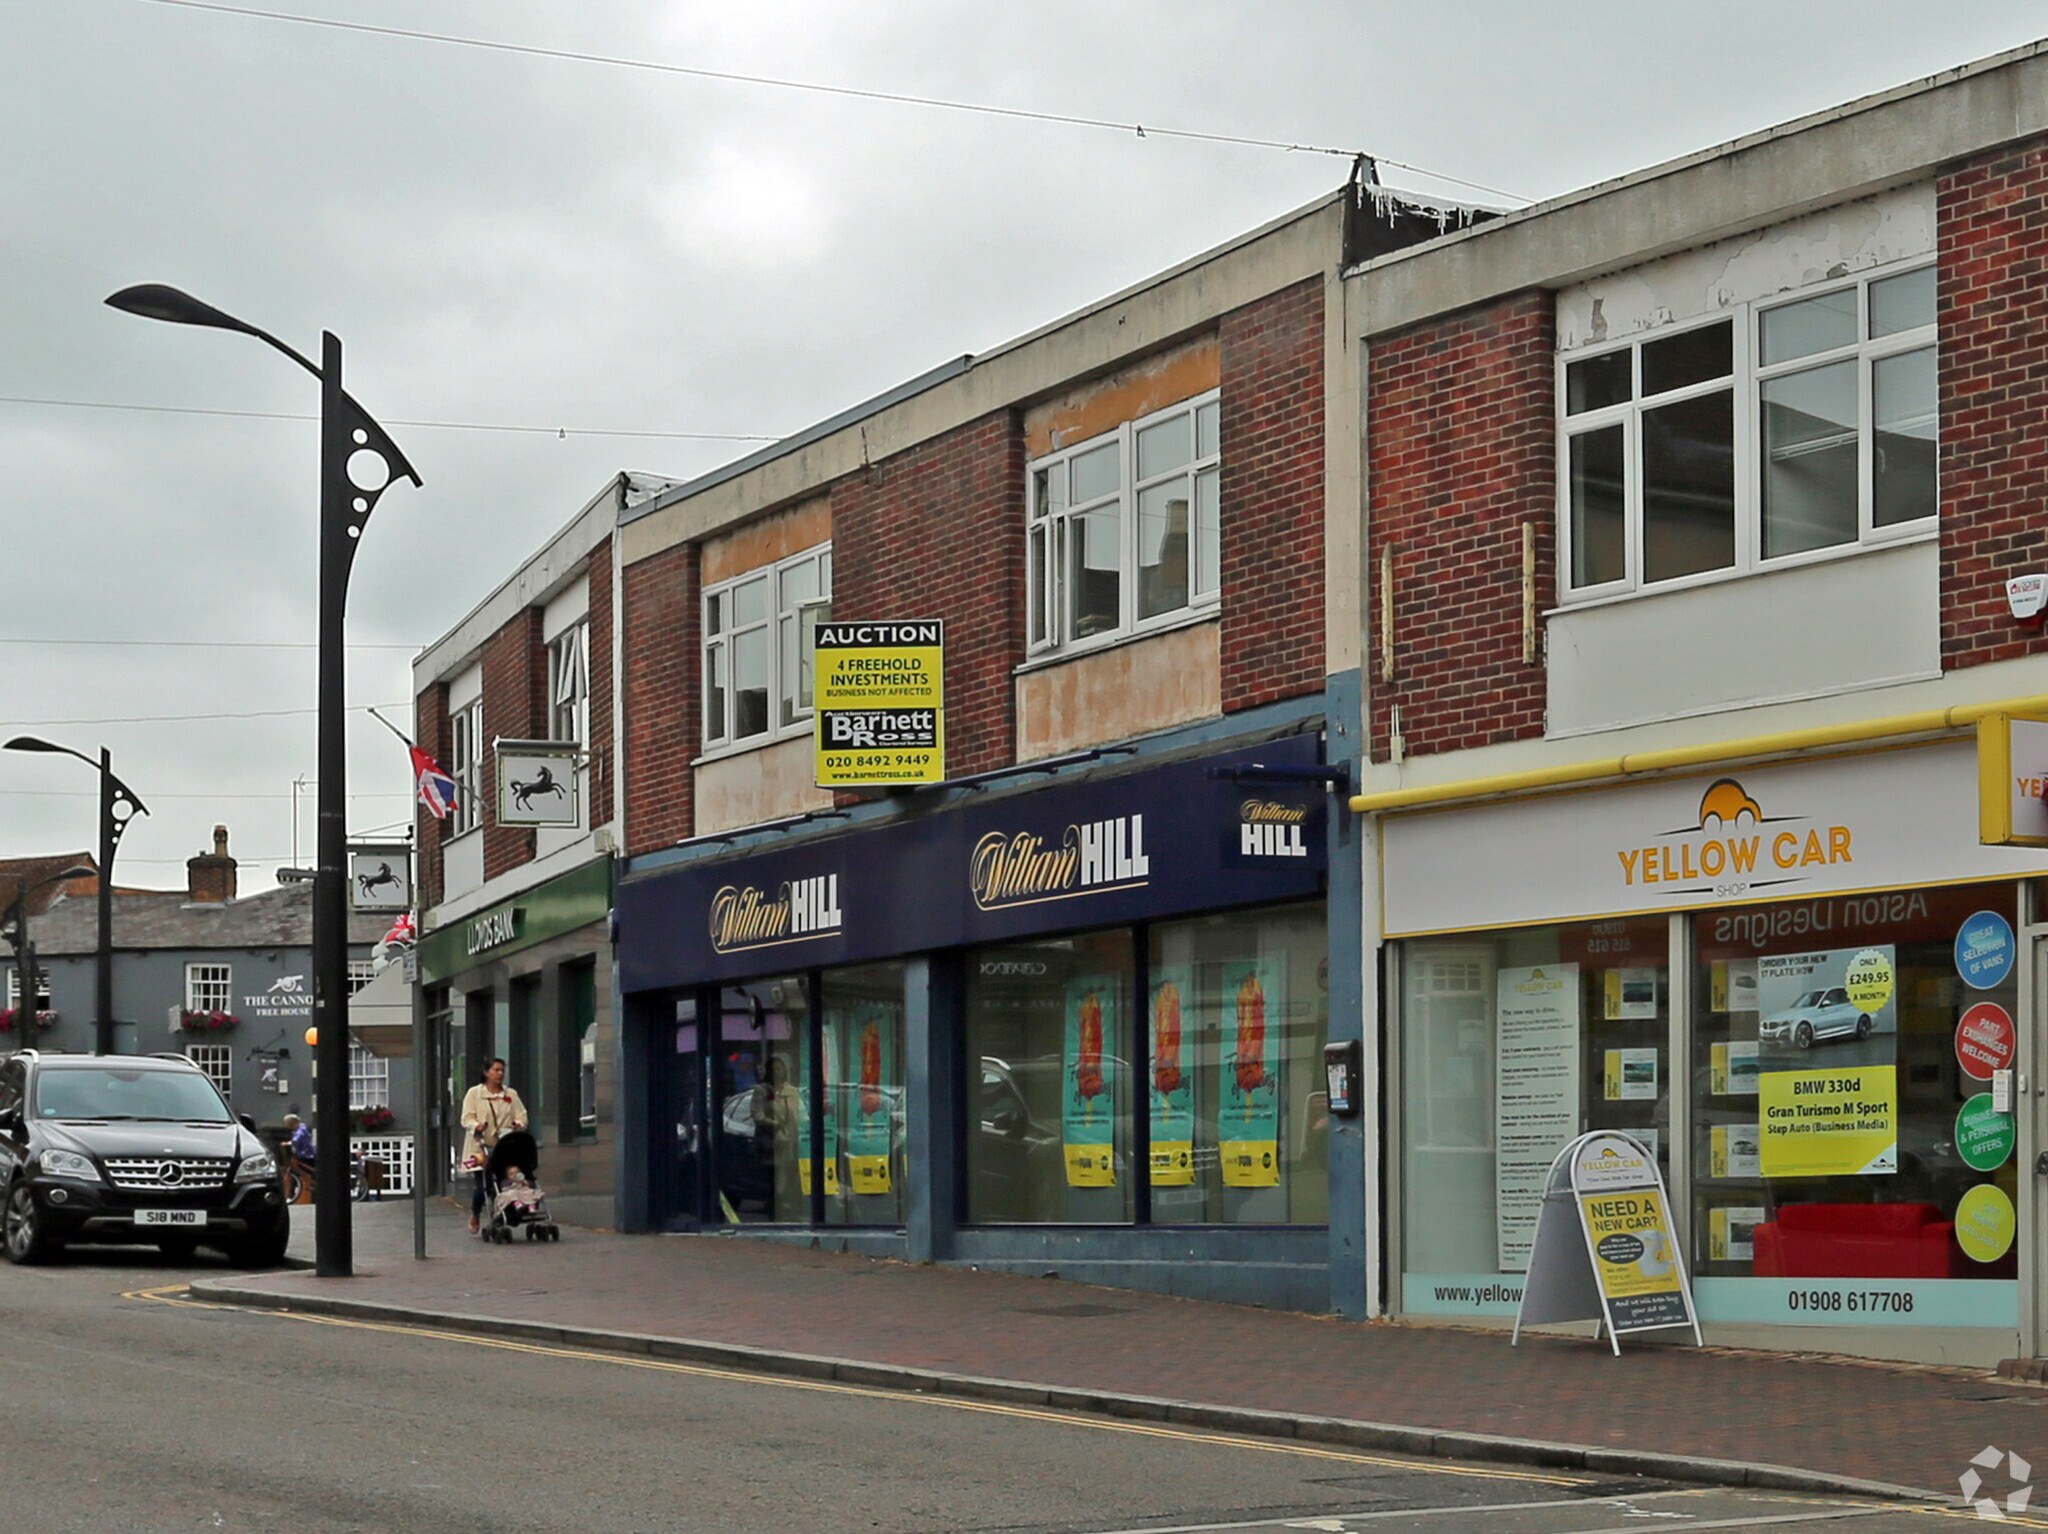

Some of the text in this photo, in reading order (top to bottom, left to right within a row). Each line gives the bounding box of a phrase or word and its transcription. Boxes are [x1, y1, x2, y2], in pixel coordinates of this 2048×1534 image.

[819, 625, 937, 645] AUCTION
[837, 658, 922, 671] 4 FREEHOLD
[830, 673, 929, 686] INVESTMENTS
[826, 686, 932, 697] BUSINESS NOT AFFECTED
[831, 711, 933, 741] Barnett
[826, 754, 930, 767] 020 8492 9449
[831, 770, 925, 780] www.barnettross.co.uk
[1240, 799, 1306, 822] William
[1241, 823, 1307, 856] HILL
[969, 813, 1149, 904] William HILL
[1617, 826, 1853, 886] YELLOW CAR
[1716, 882, 1747, 897] SHOP
[708, 873, 842, 948] William HILL
[467, 907, 515, 955] LLOYDS BANK
[1761, 954, 1828, 968] ORDER YOUR NEW
[1859, 957, 1878, 967] ONLY
[1969, 954, 2005, 975] OF VANS
[1769, 968, 1795, 977] PLATE
[1795, 966, 1814, 975] NOW
[1849, 972, 1890, 985] £249.95
[243, 994, 314, 1007] THE CANNO
[1859, 991, 1886, 1001] MONTH
[256, 1007, 311, 1016] FREE HOUSE
[1979, 1017, 2001, 1035] PART
[1961, 1042, 2001, 1069] WELCOME
[1794, 1077, 1861, 1095] BMW 330d
[1767, 1101, 1888, 1118] Gran Turismo M Sport
[1767, 1119, 1889, 1135] Step Auto (Business Media)
[1582, 1159, 1644, 1171] YELLOW CAR
[1590, 1198, 1656, 1219] NEED A
[170, 1211, 196, 1223] MND
[1594, 1216, 1658, 1232] NEW CAR?
[1434, 1283, 1523, 1307] www.yellow
[1788, 1290, 1914, 1313] 01908 617708
